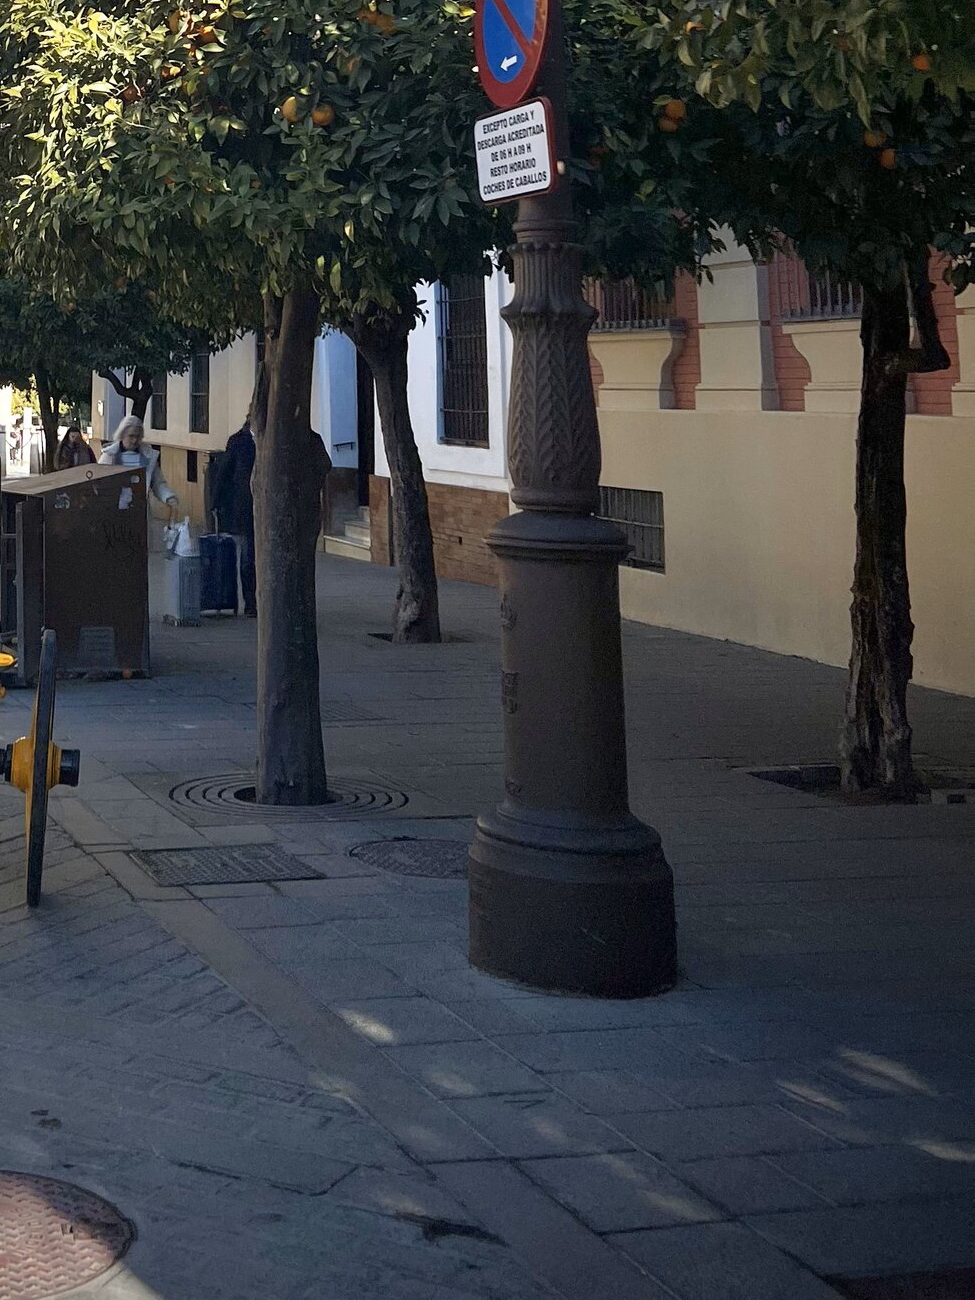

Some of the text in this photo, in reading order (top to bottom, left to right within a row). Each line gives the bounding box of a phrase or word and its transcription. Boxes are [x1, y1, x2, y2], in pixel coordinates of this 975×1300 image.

[483, 110, 534, 134] EXCEPTO CARGA Y
[477, 124, 544, 151] DESCARGA ACREDITADA
[491, 143, 531, 162] DE 06 H A 09 H
[490, 157, 536, 177] RESTO HORARIO
[483, 171, 546, 195] COCHES DE CABALLOS
